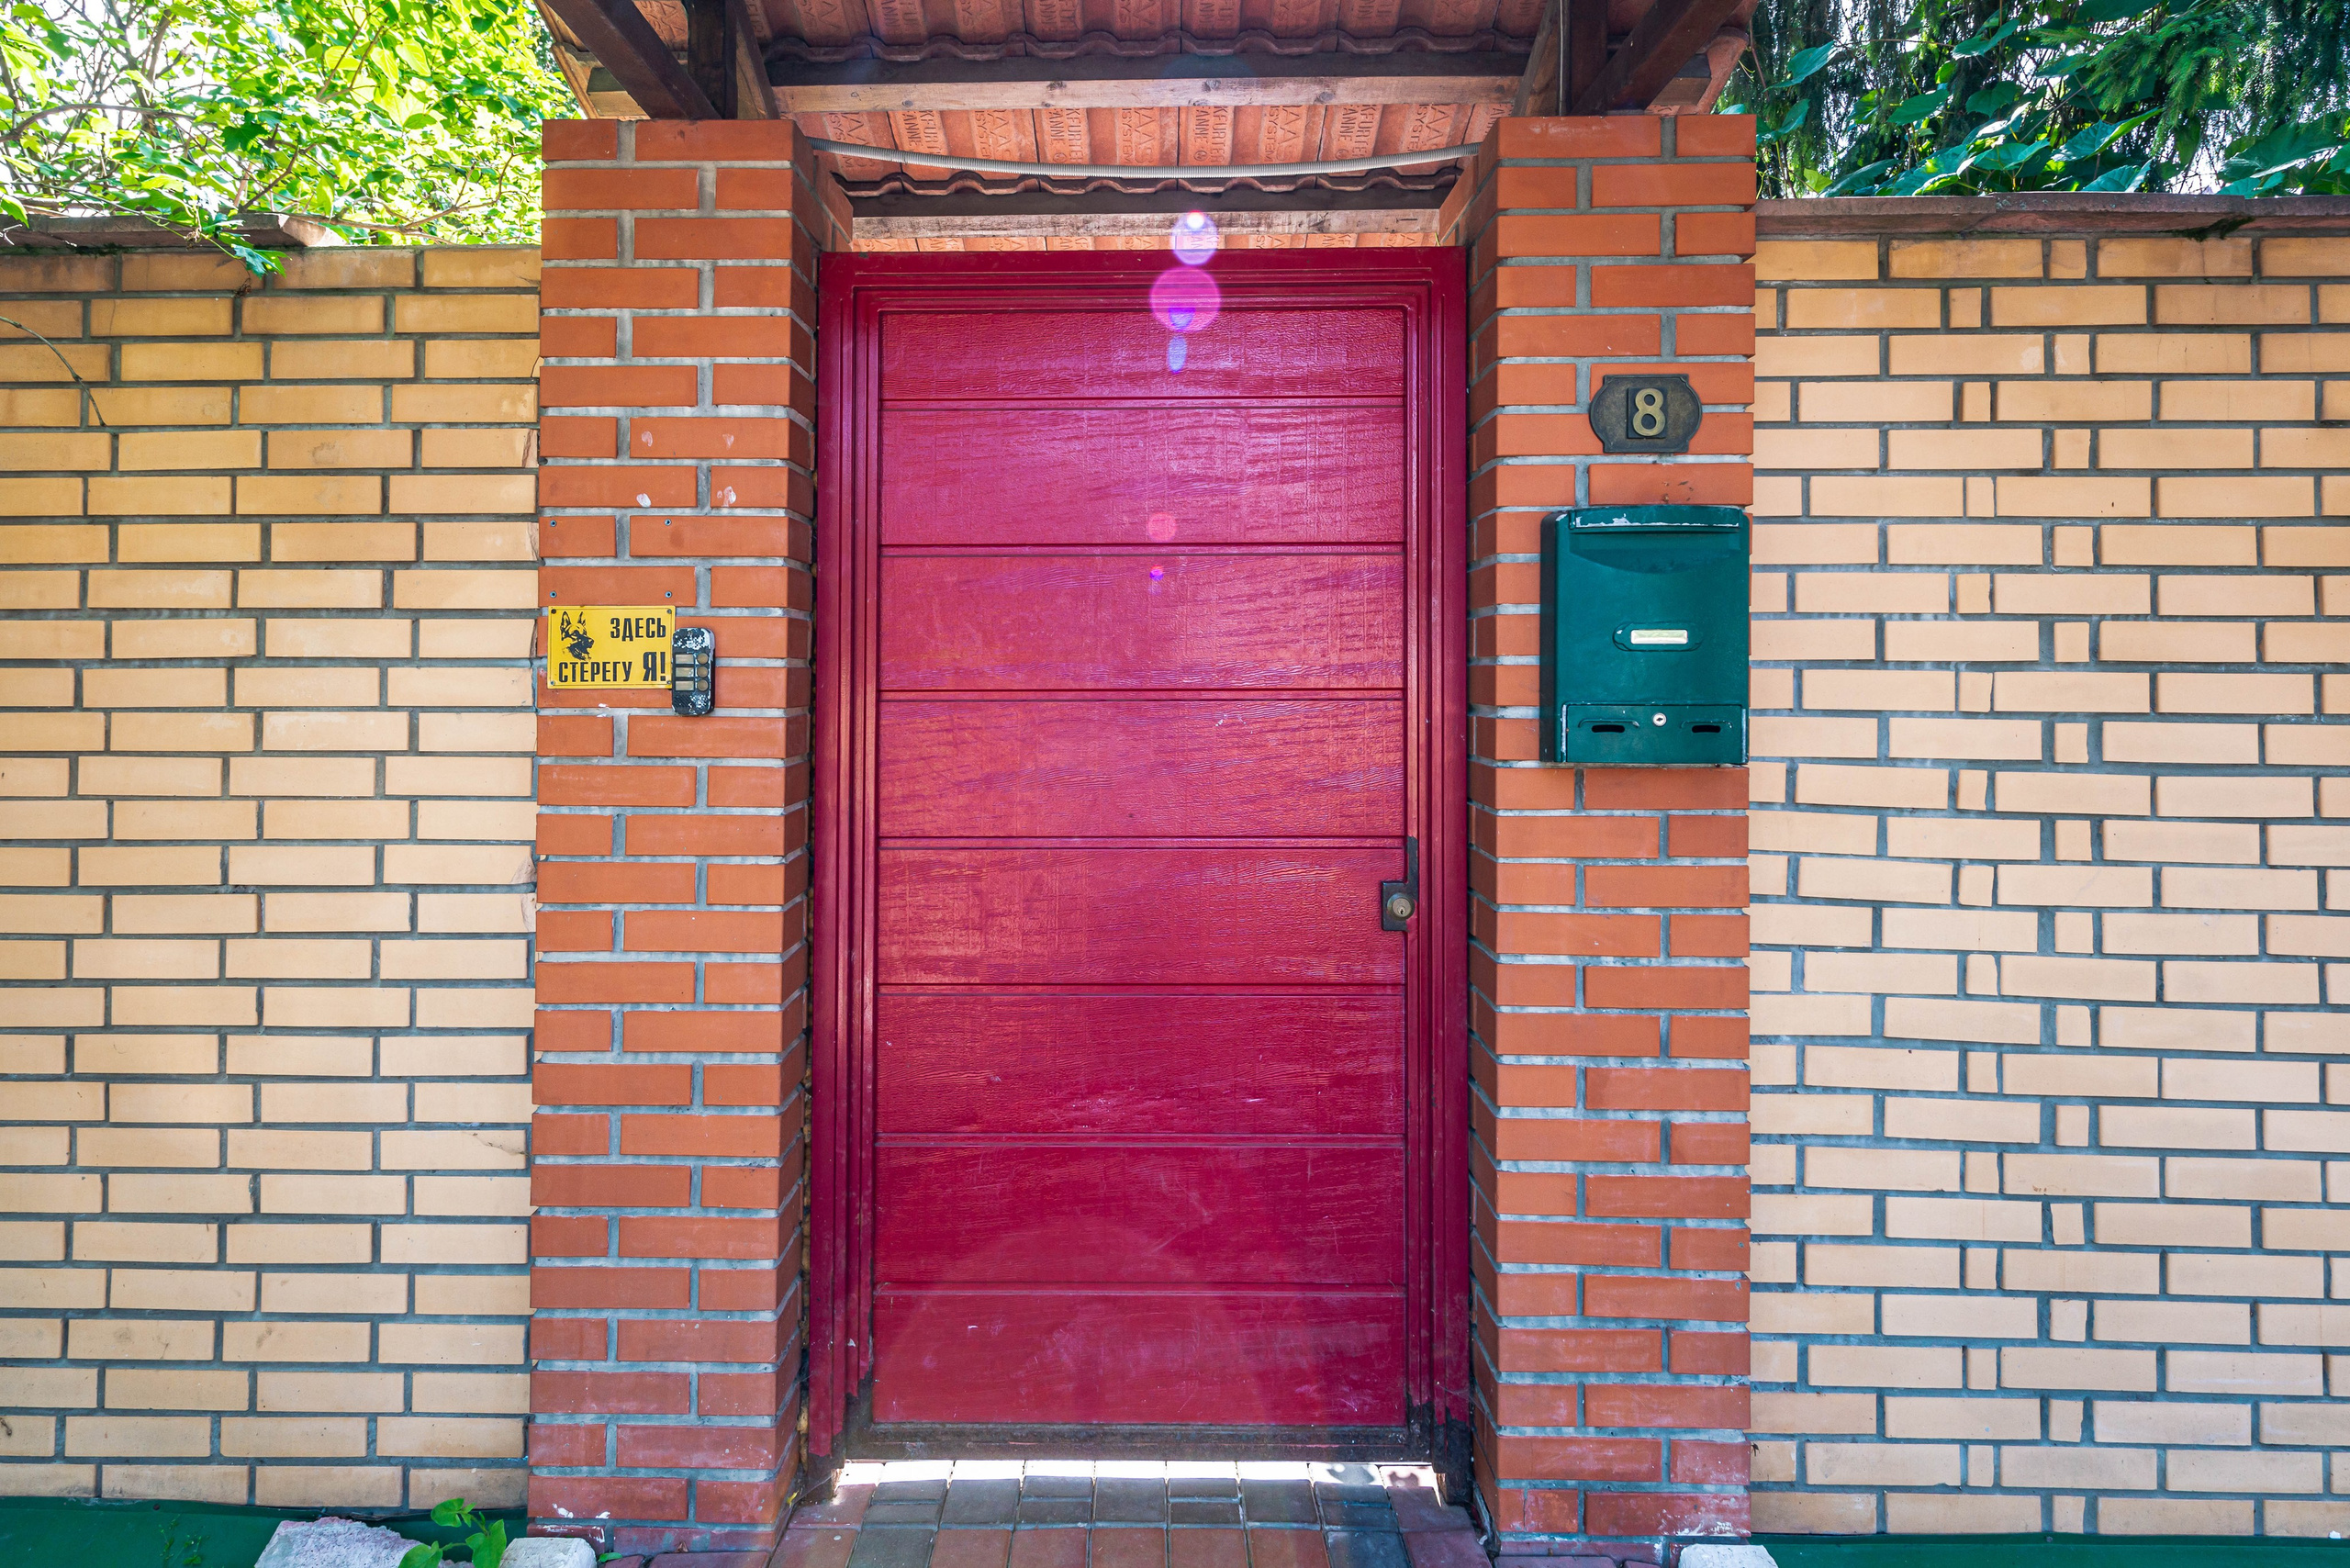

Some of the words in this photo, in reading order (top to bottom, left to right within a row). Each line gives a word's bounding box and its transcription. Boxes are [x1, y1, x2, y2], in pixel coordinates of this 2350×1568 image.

[1632, 387, 1666, 436] 8
[610, 617, 666, 642] ЗДЕСЬ
[558, 661, 632, 683] СТЕРЕГУ
[643, 651, 666, 682] Я!
